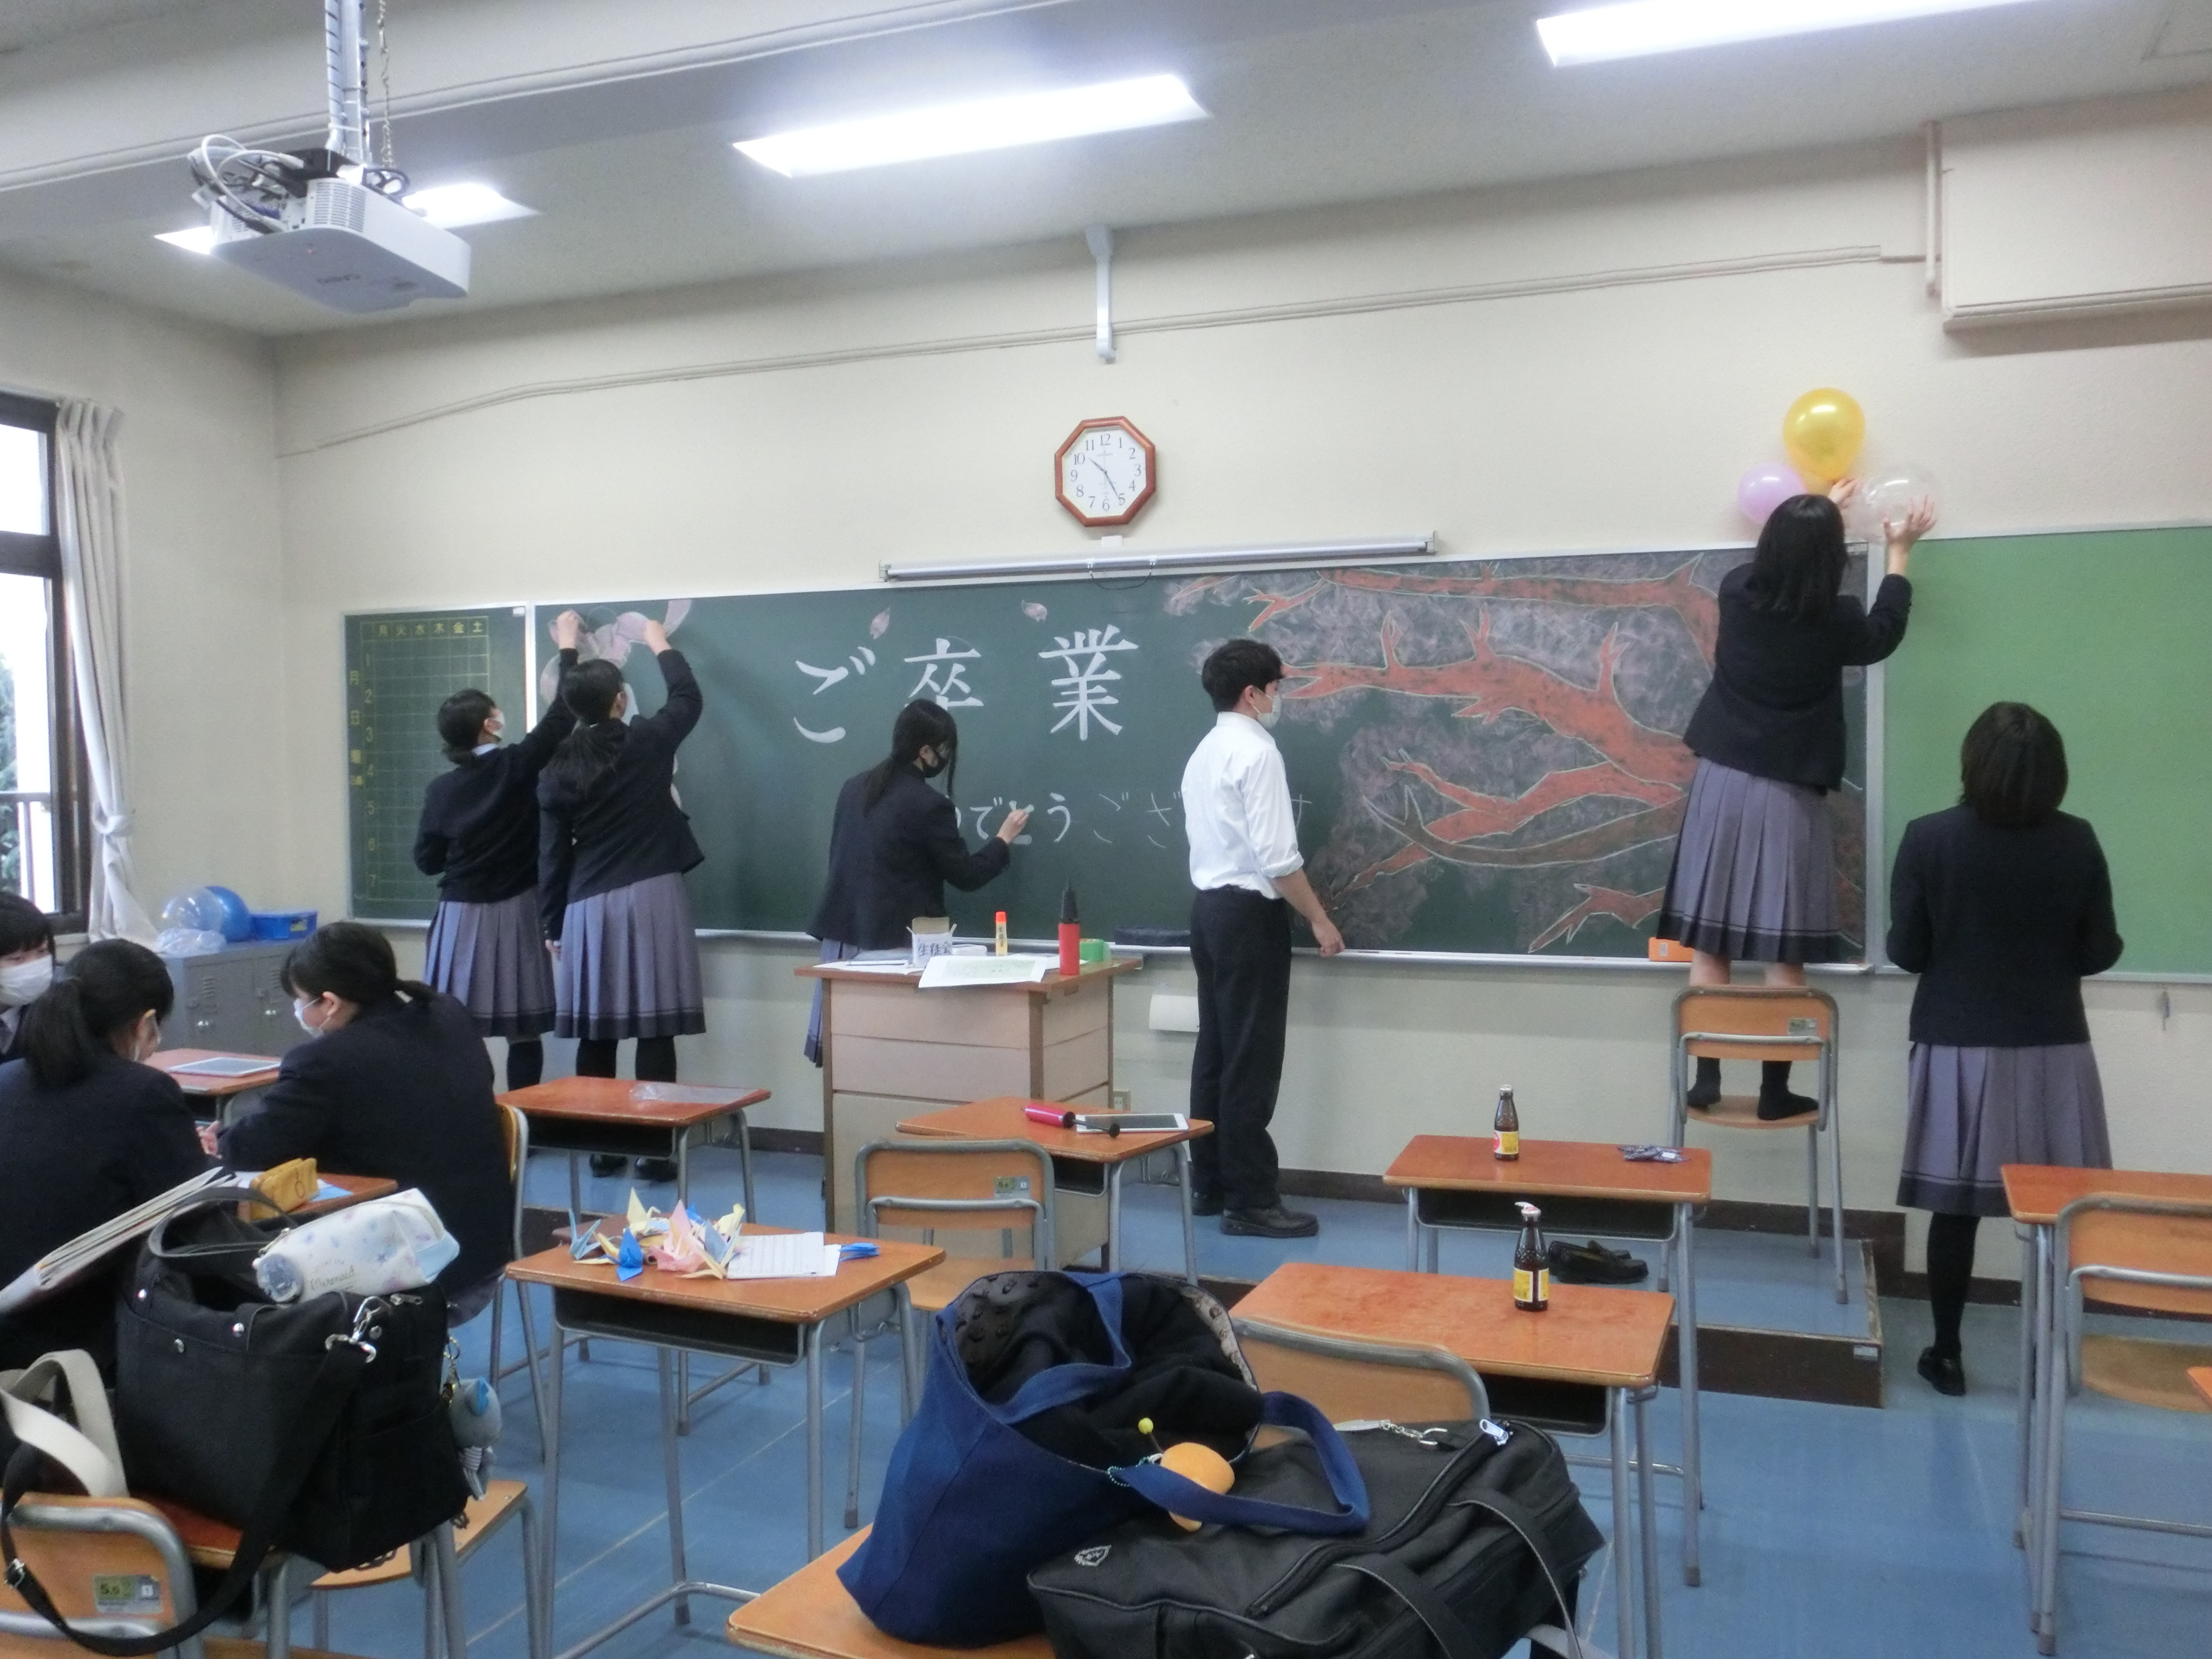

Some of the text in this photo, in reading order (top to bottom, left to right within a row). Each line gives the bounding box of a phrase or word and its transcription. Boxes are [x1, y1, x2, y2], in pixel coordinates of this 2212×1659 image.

[1085, 439, 1094, 451] 11
[1100, 433, 1111, 446] 12
[1119, 437, 1122, 448] 1
[1073, 453, 1085, 465] 10
[1129, 447, 1136, 459] 2
[1070, 469, 1078, 482] 9
[1134, 464, 1141, 476] 3
[1076, 485, 1084, 497] 8
[1129, 480, 1135, 491] 4
[1089, 496, 1095, 508] 7
[1103, 499, 1110, 511] 6
[1119, 493, 1125, 505] 5
[453, 621, 464, 634] 金
[473, 621, 482, 633] 土
[364, 689, 372, 703] 2
[366, 727, 373, 742] 3
[367, 800, 374, 815] 5
[369, 837, 375, 851] 6
[370, 874, 376, 887] 7
